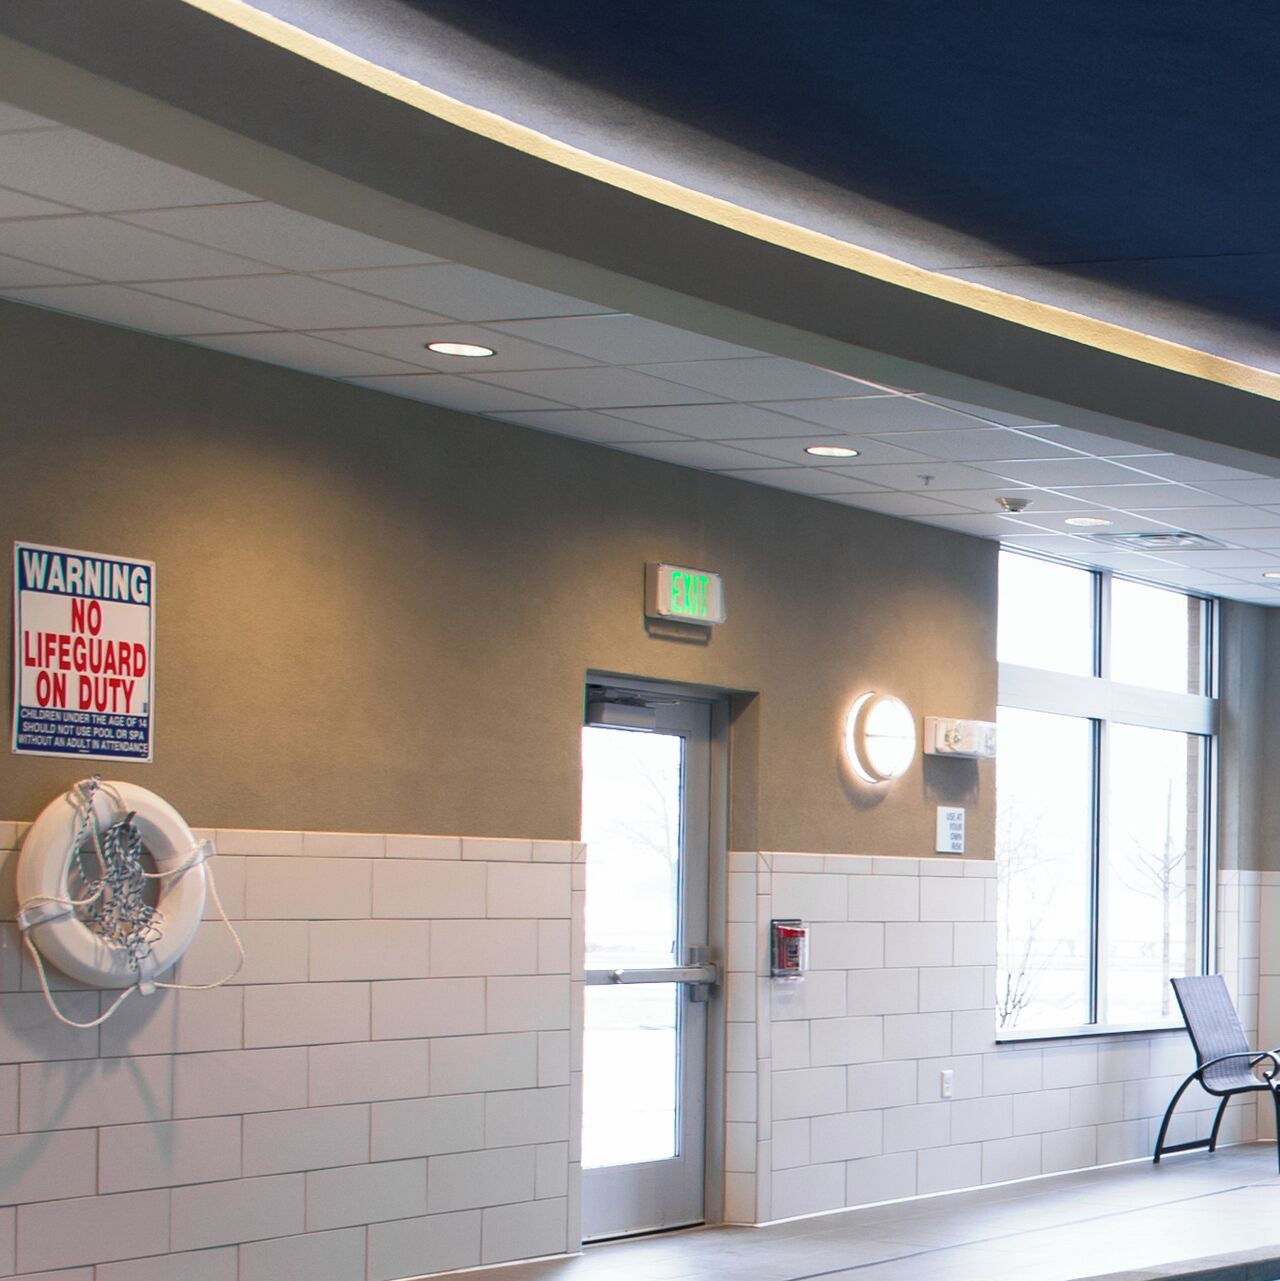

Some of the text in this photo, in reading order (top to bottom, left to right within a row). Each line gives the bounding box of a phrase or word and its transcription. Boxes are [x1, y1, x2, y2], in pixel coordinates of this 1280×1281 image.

[23, 550, 148, 603] WARNING
[671, 570, 709, 617] EXIT
[72, 598, 101, 636] NO
[24, 630, 146, 678] LIFEGUARD
[36, 670, 135, 713] ON DUTY
[20, 708, 147, 728] CHILDREN UNDER THE AGE OF 14
[22, 721, 144, 740] SHOULD NOT USE POOL OR SPA
[18, 733, 148, 753] WITHOUT AN ADULT IN ATTENDANCE
